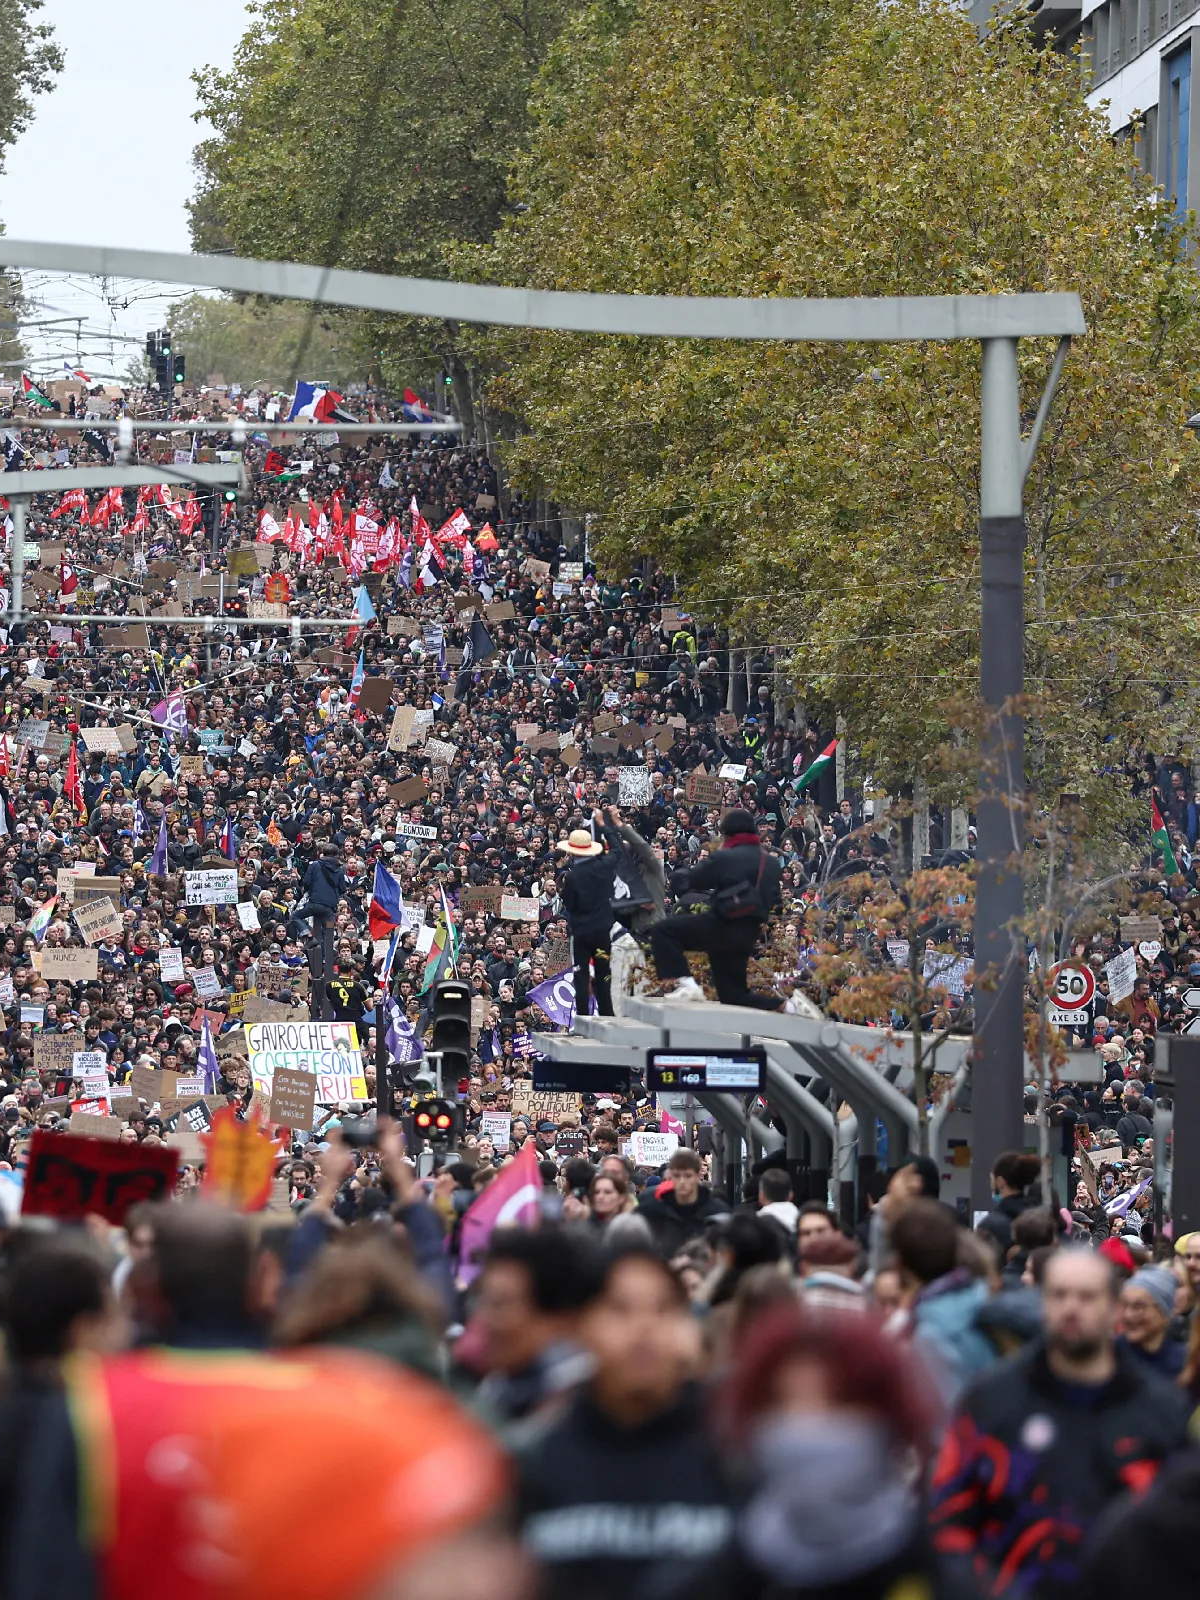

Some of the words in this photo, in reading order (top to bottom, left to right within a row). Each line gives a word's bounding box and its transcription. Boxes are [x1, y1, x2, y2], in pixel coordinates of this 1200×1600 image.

[404, 825, 430, 837] BONJOUR
[1057, 976, 1084, 995] 50
[339, 988, 350, 1006] 9
[1052, 1014, 1070, 1022] AXE
[1074, 1014, 1085, 1022] 50
[249, 1024, 330, 1052] GAVROCHE
[320, 1051, 361, 1075] SONT
[661, 1072, 674, 1082] 13
[682, 1074, 700, 1082] +60
[321, 1077, 368, 1100] RUE
[514, 1081, 528, 1090] CE
[514, 1092, 532, 1101] EST
[532, 1092, 564, 1100] COMME
[564, 1092, 576, 1100] TA
